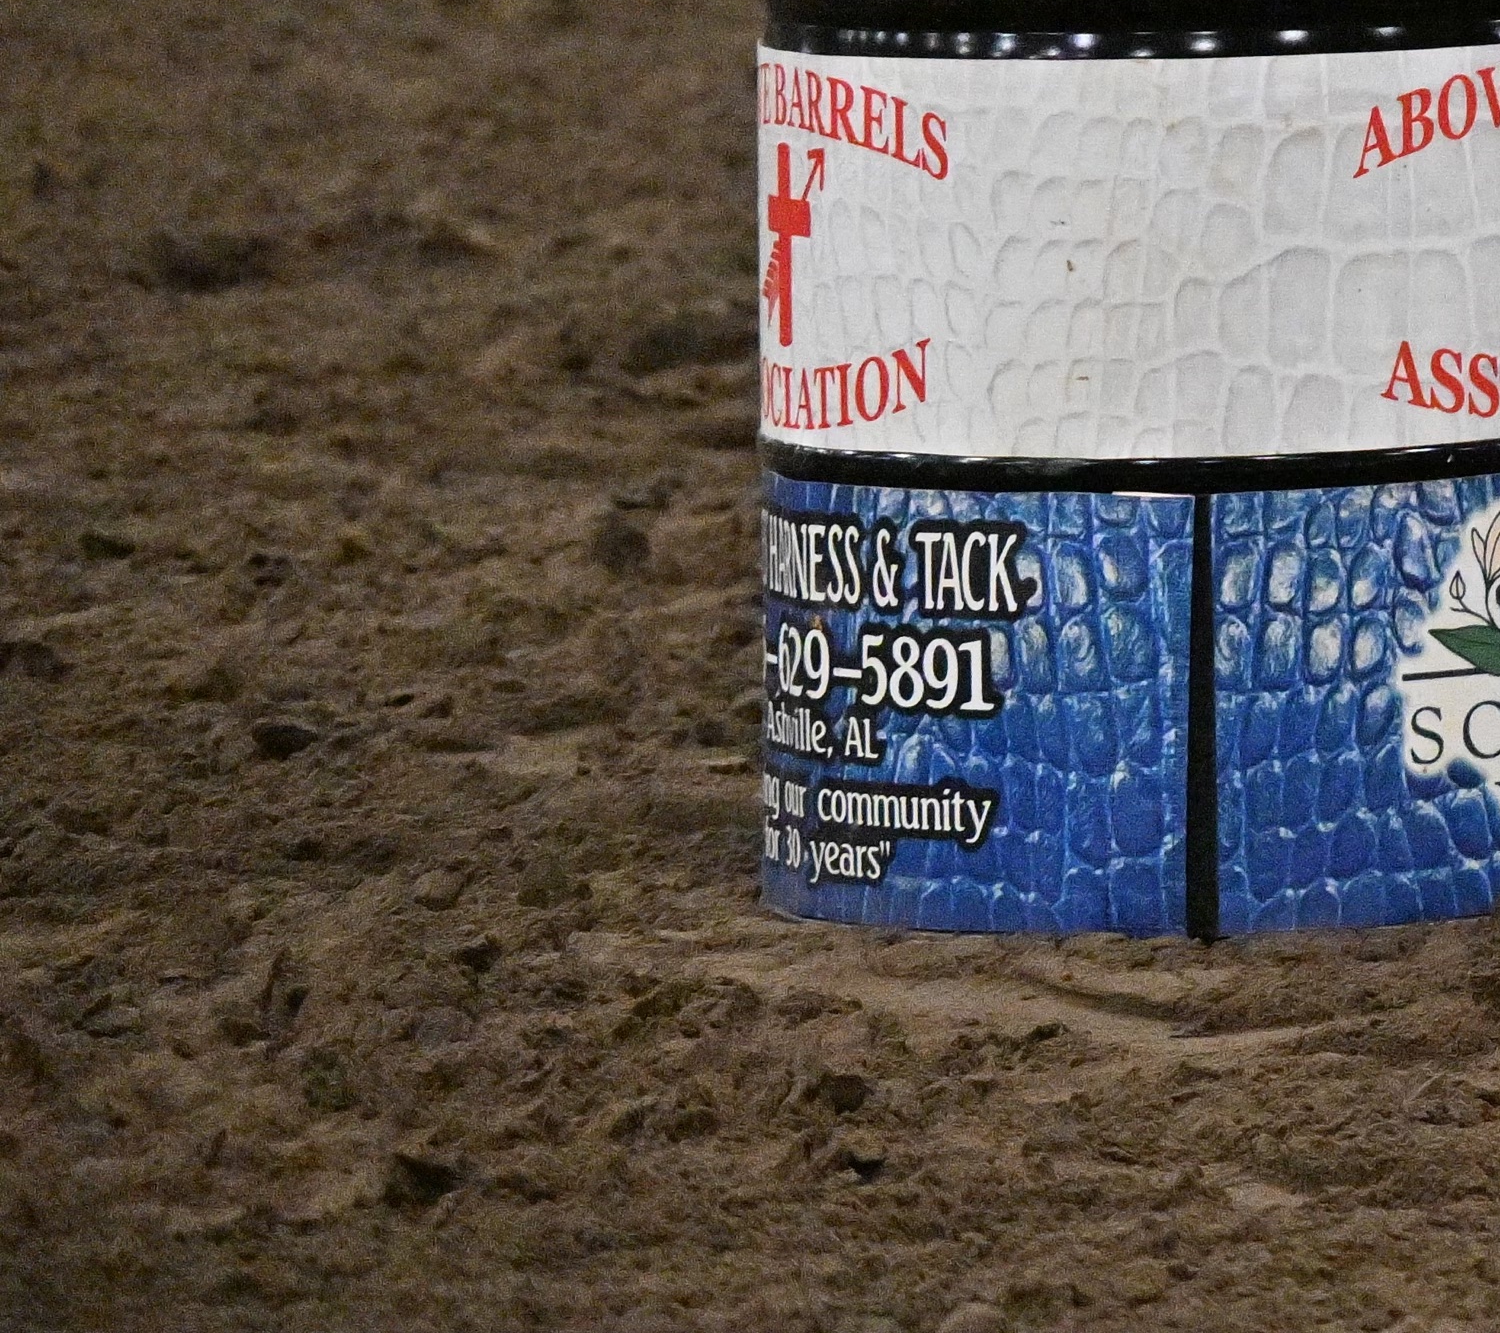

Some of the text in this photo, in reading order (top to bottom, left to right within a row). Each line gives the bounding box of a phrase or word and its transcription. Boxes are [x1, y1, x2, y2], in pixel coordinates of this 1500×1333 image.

[774, 63, 949, 180] BARRELS
[872, 528, 899, 607] &
[915, 532, 1019, 613] TACK
[844, 716, 880, 760] AL
[817, 788, 991, 844] community
[809, 840, 891, 884] years"
